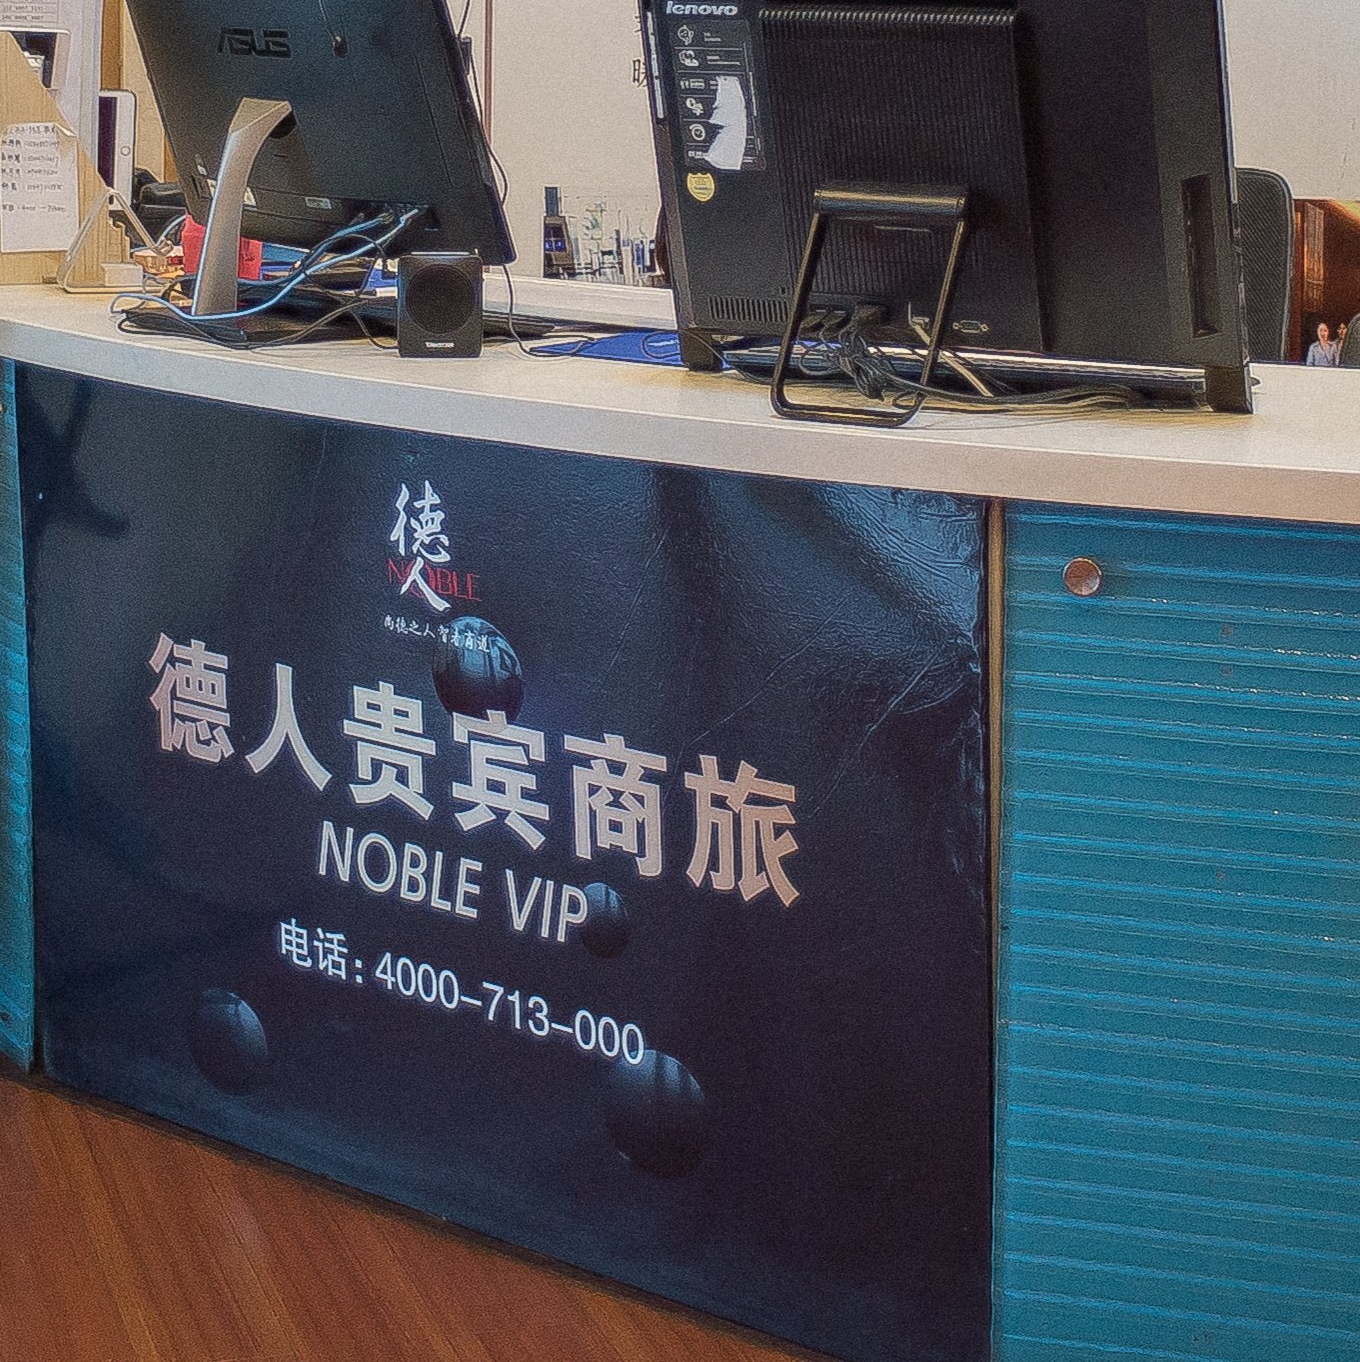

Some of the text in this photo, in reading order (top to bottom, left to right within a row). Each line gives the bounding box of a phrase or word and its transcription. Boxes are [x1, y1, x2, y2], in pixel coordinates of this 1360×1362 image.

[218, 27, 292, 59] ASUS
[666, 1, 738, 16] lenovo
[149, 632, 801, 908] 德人贵宾商旅
[318, 820, 589, 943] NOBLE VIP
